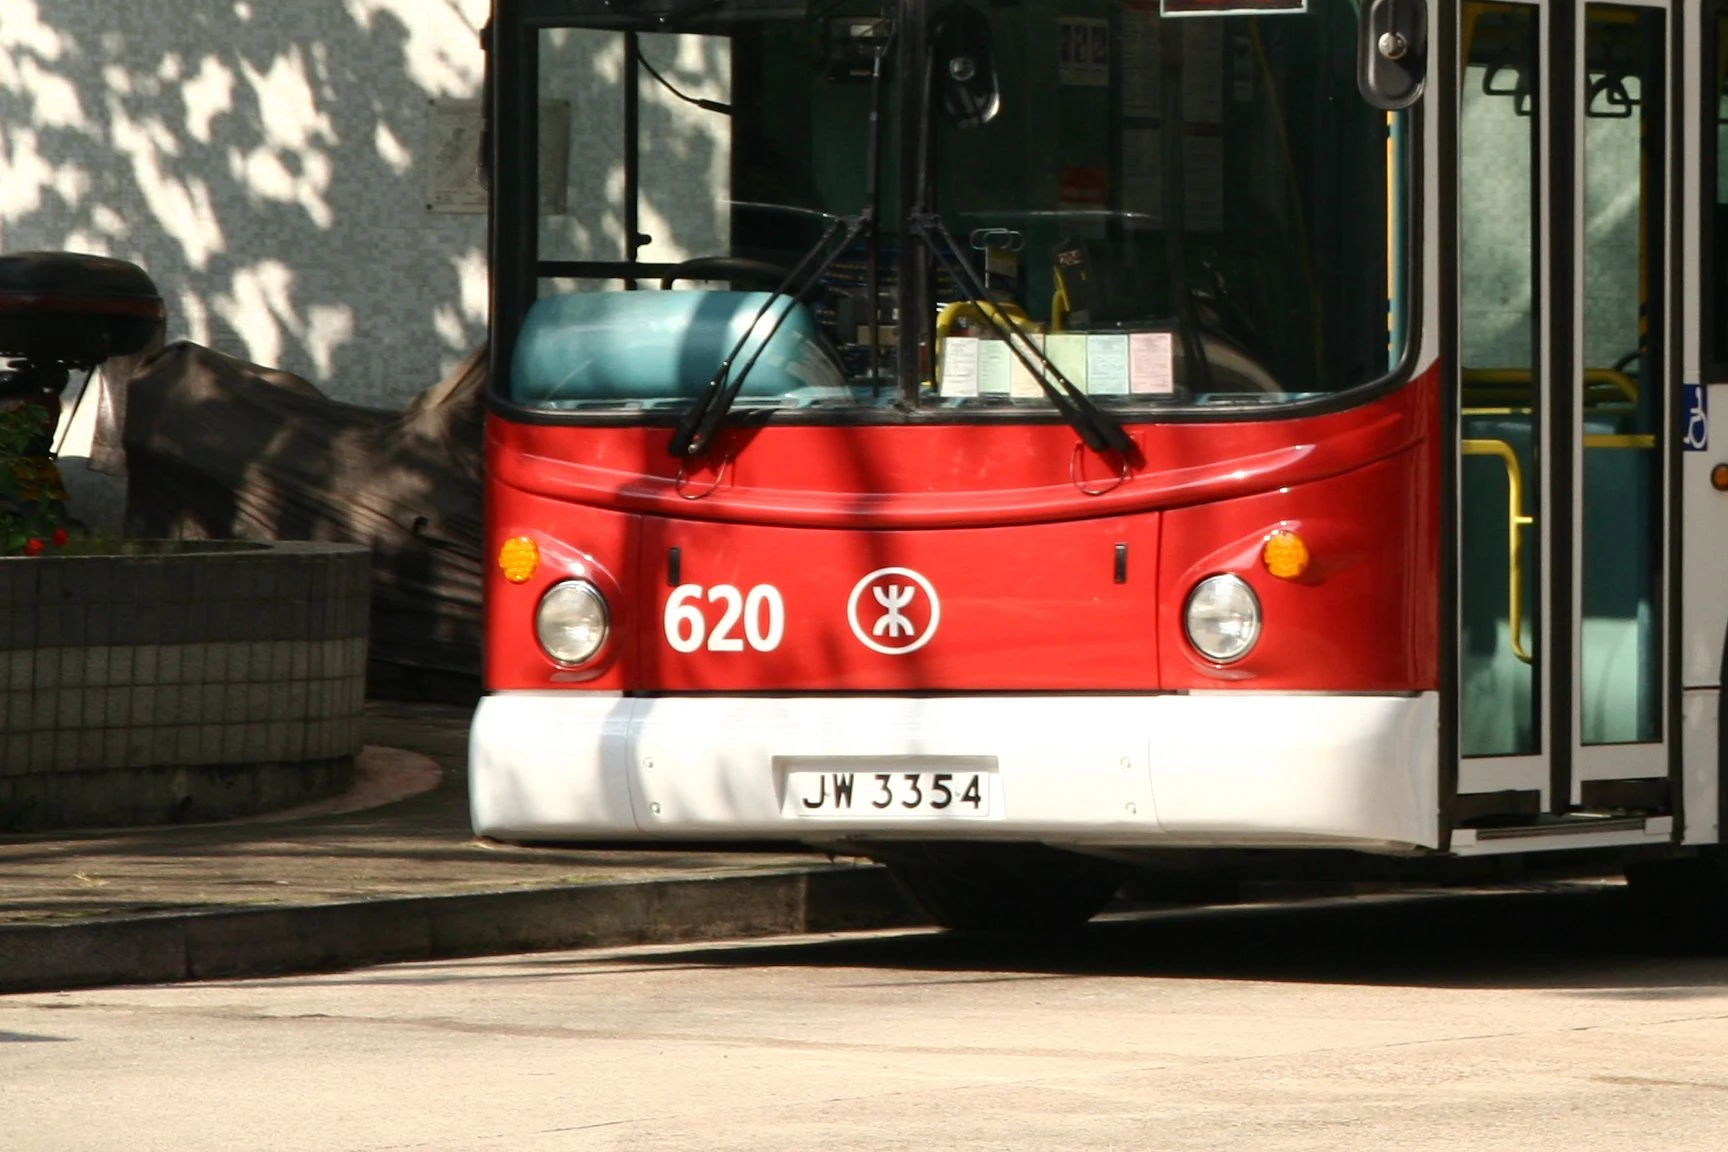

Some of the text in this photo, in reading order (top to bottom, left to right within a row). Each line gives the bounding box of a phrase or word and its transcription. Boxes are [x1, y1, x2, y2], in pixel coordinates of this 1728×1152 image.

[663, 583, 786, 654] 620
[802, 773, 983, 810] JW 3354
